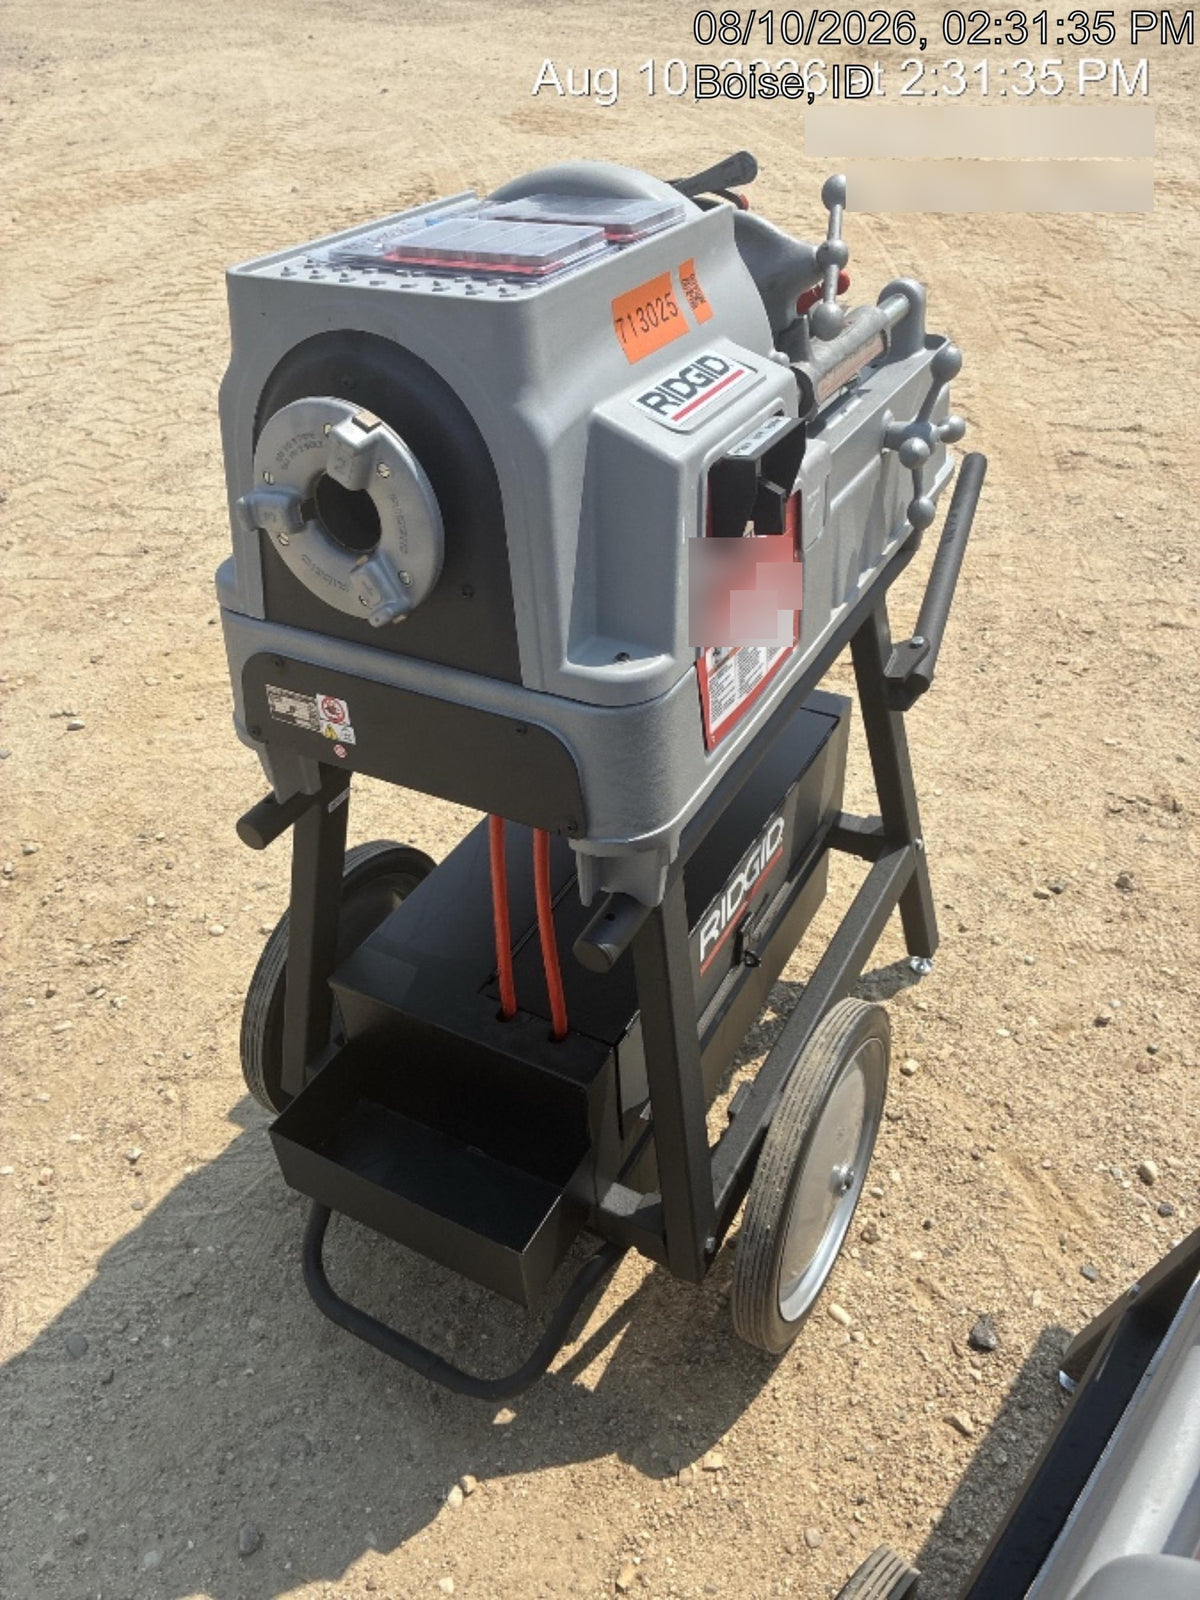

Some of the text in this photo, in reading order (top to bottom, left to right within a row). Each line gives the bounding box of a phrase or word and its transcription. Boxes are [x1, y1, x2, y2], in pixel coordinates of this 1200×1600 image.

[615, 291, 679, 343] 713025
[636, 355, 730, 416] RIDGID
[700, 816, 785, 963] RIDGID
